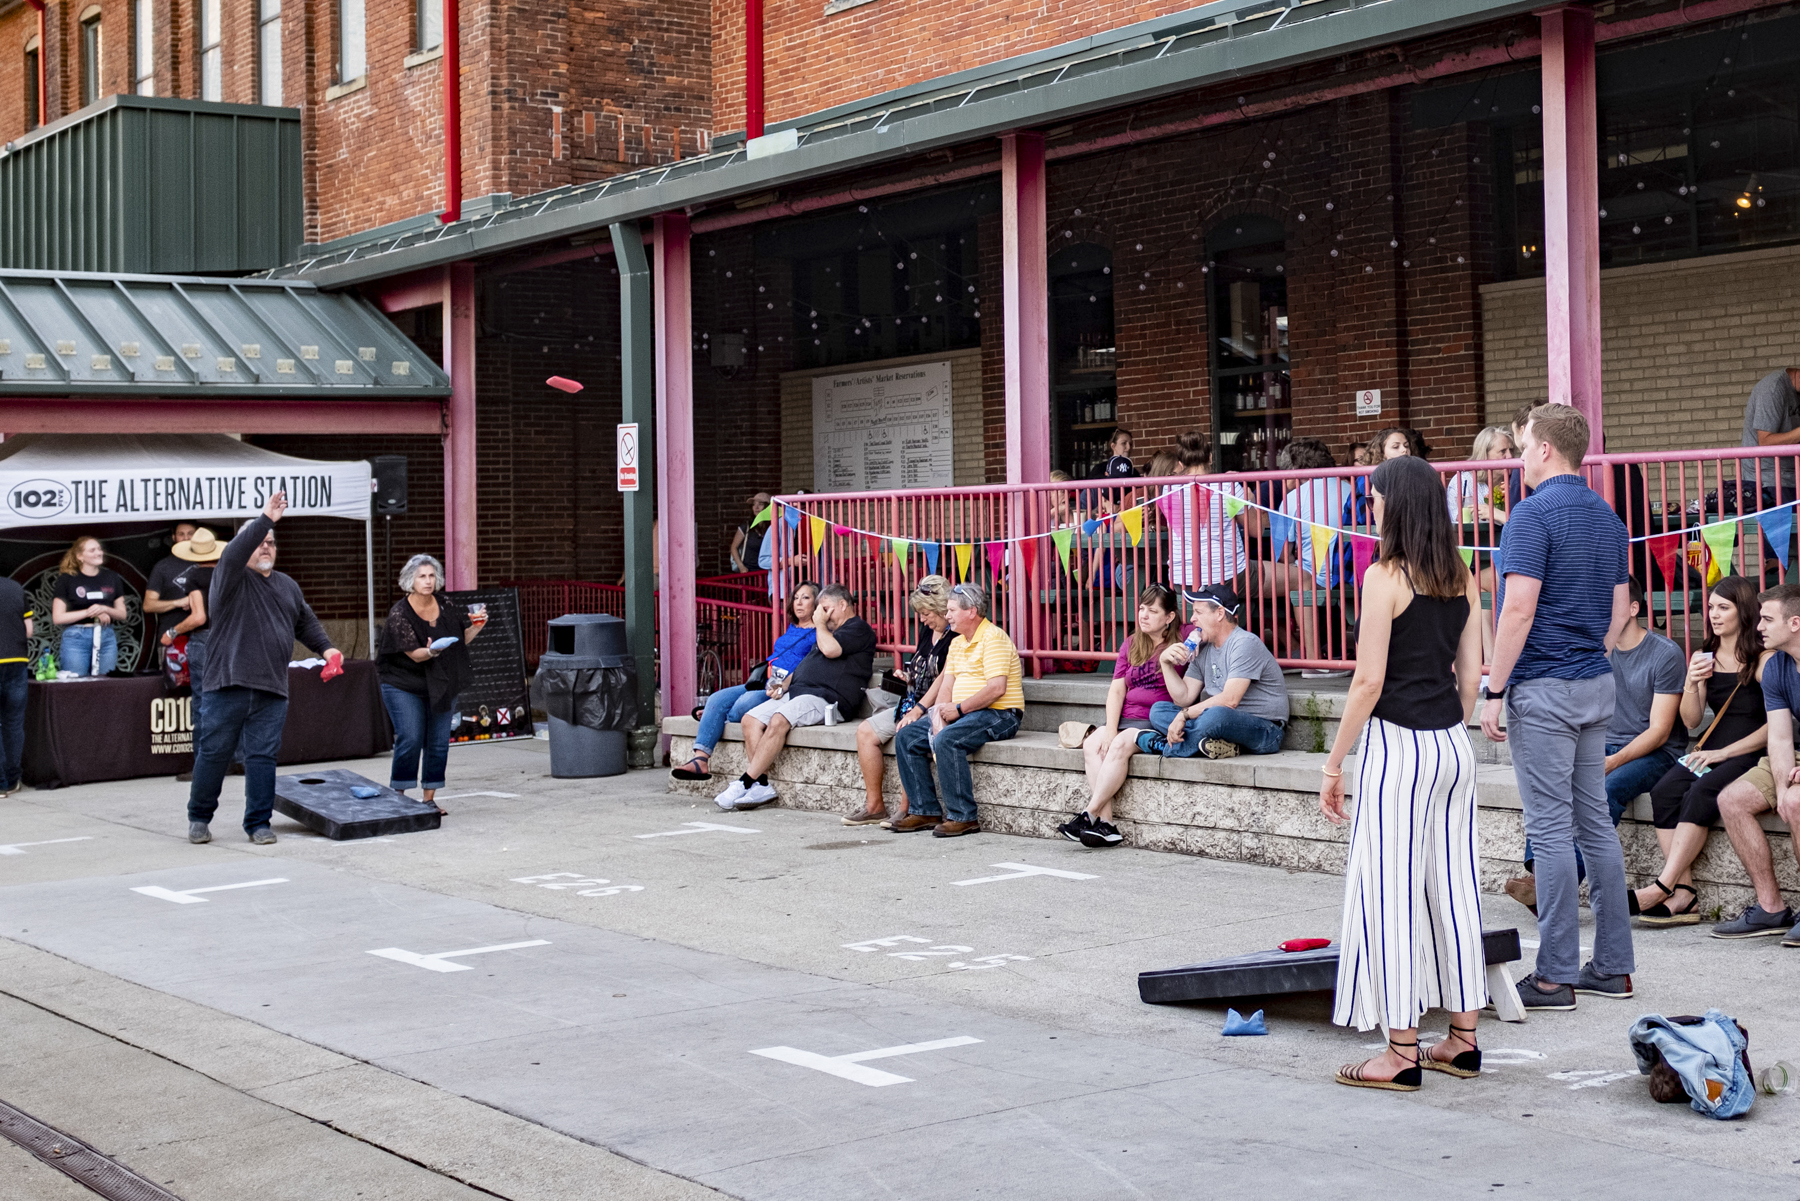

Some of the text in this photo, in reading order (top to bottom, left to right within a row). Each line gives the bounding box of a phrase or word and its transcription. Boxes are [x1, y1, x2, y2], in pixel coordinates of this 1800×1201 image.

[876, 374, 894, 383] Market
[895, 370, 926, 381] Reservations
[14, 490, 57, 508] 102
[71, 475, 332, 514] THE ALTERNATIVE STATION
[152, 734, 162, 744] THE
[508, 872, 645, 897] E26
[840, 934, 1036, 969] E25
